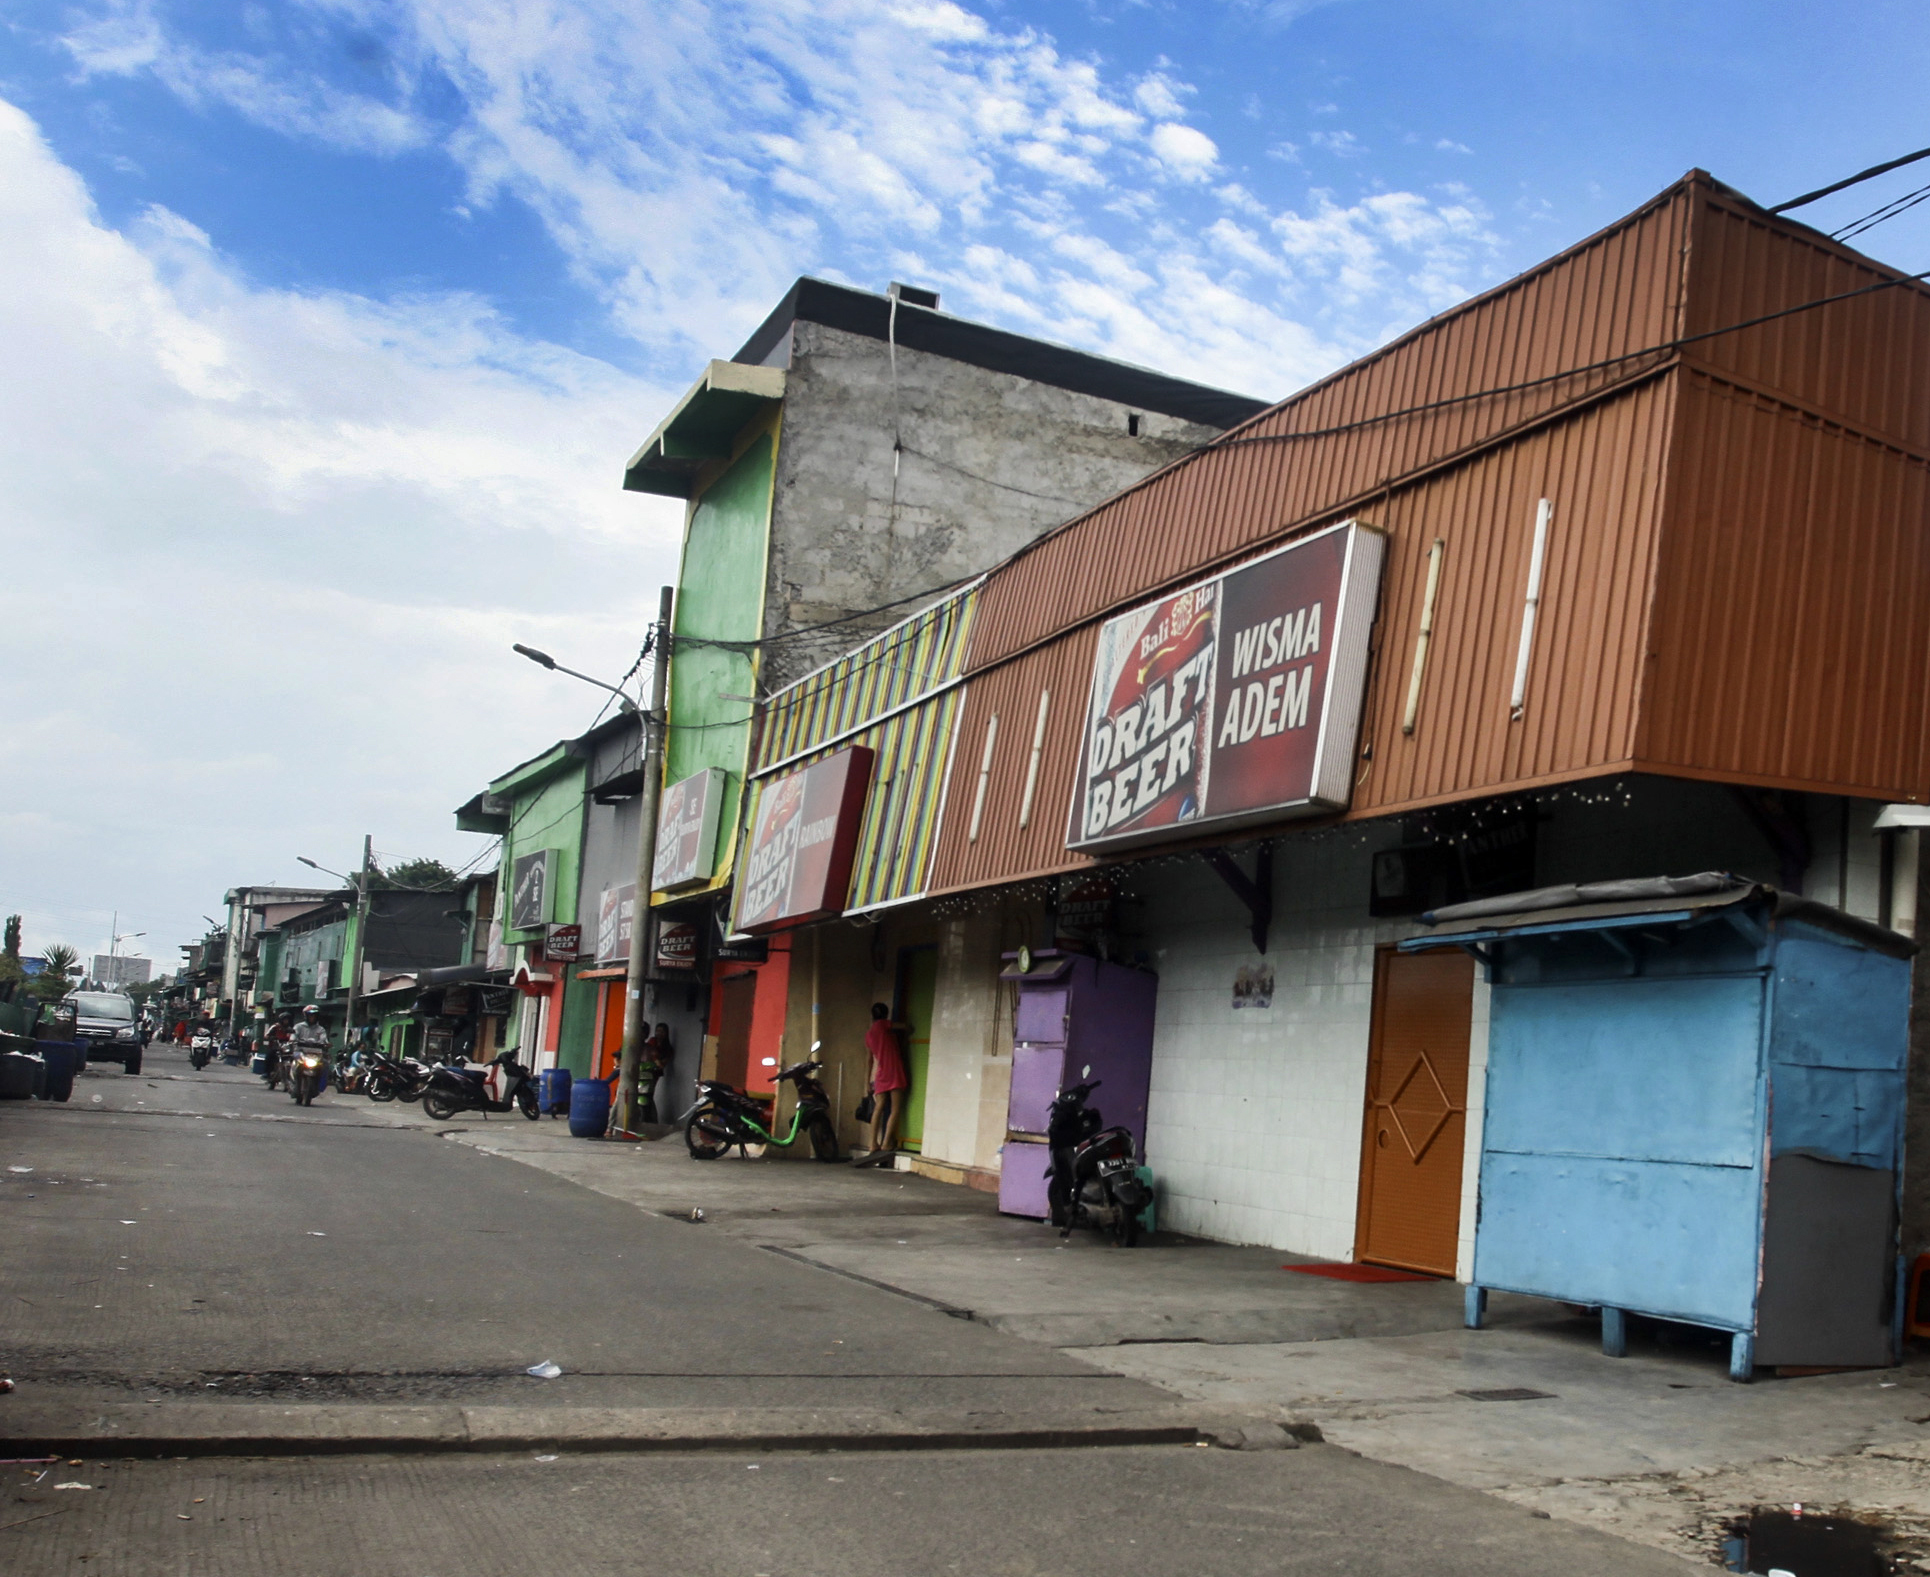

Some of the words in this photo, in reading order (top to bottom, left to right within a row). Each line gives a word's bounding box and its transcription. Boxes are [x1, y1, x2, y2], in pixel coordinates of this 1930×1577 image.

[1140, 618, 1170, 660] Bali
[1232, 602, 1321, 678] WISMA
[1090, 641, 1215, 778] DRAFT
[1218, 665, 1312, 749] ADEM
[1086, 720, 1197, 838] BEER
[749, 818, 799, 886] DRAFT
[745, 855, 790, 924] BEER
[1060, 900, 1111, 914] DRAFT
[549, 935, 578, 943] DRAFT
[660, 936, 696, 945] DRAFT
[662, 944, 691, 952] BEER
